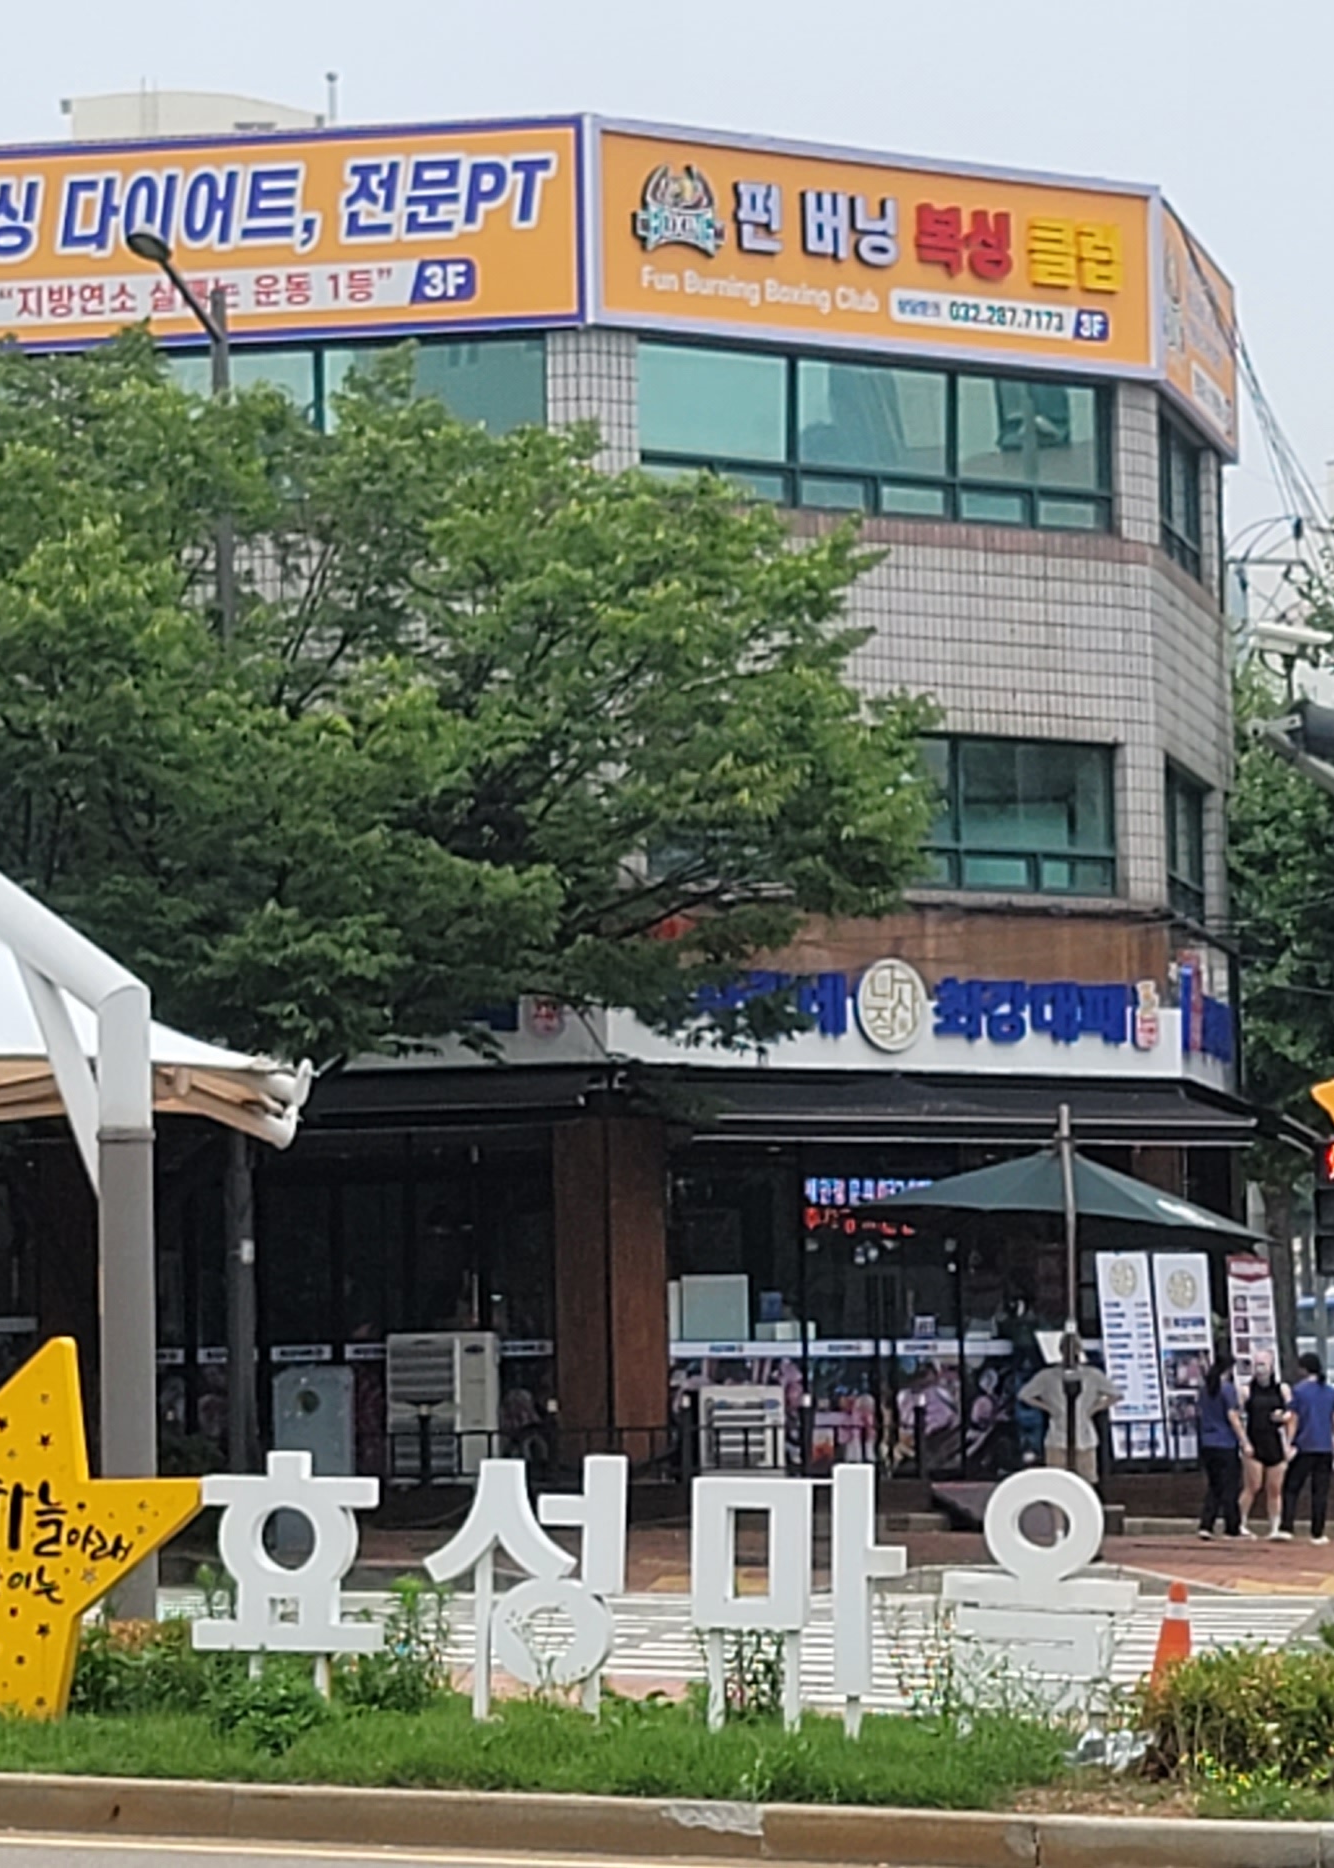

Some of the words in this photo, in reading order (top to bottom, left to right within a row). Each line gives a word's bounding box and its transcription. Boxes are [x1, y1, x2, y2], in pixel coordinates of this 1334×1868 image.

[60, 168, 322, 251] 다이어트,
[344, 158, 552, 240] 전문PT
[800, 190, 899, 267] 버닝
[916, 203, 1012, 280] 복싱
[1027, 217, 1122, 293] 클럽
[254, 273, 312, 305] 운동
[423, 265, 467, 297] 3F
[642, 266, 678, 291] Fun
[683, 270, 761, 307] Burning
[765, 278, 832, 314] Boxing
[835, 286, 879, 312] Club
[1078, 313, 1105, 337] 3F
[192, 1450, 1141, 1710] 효성마을
